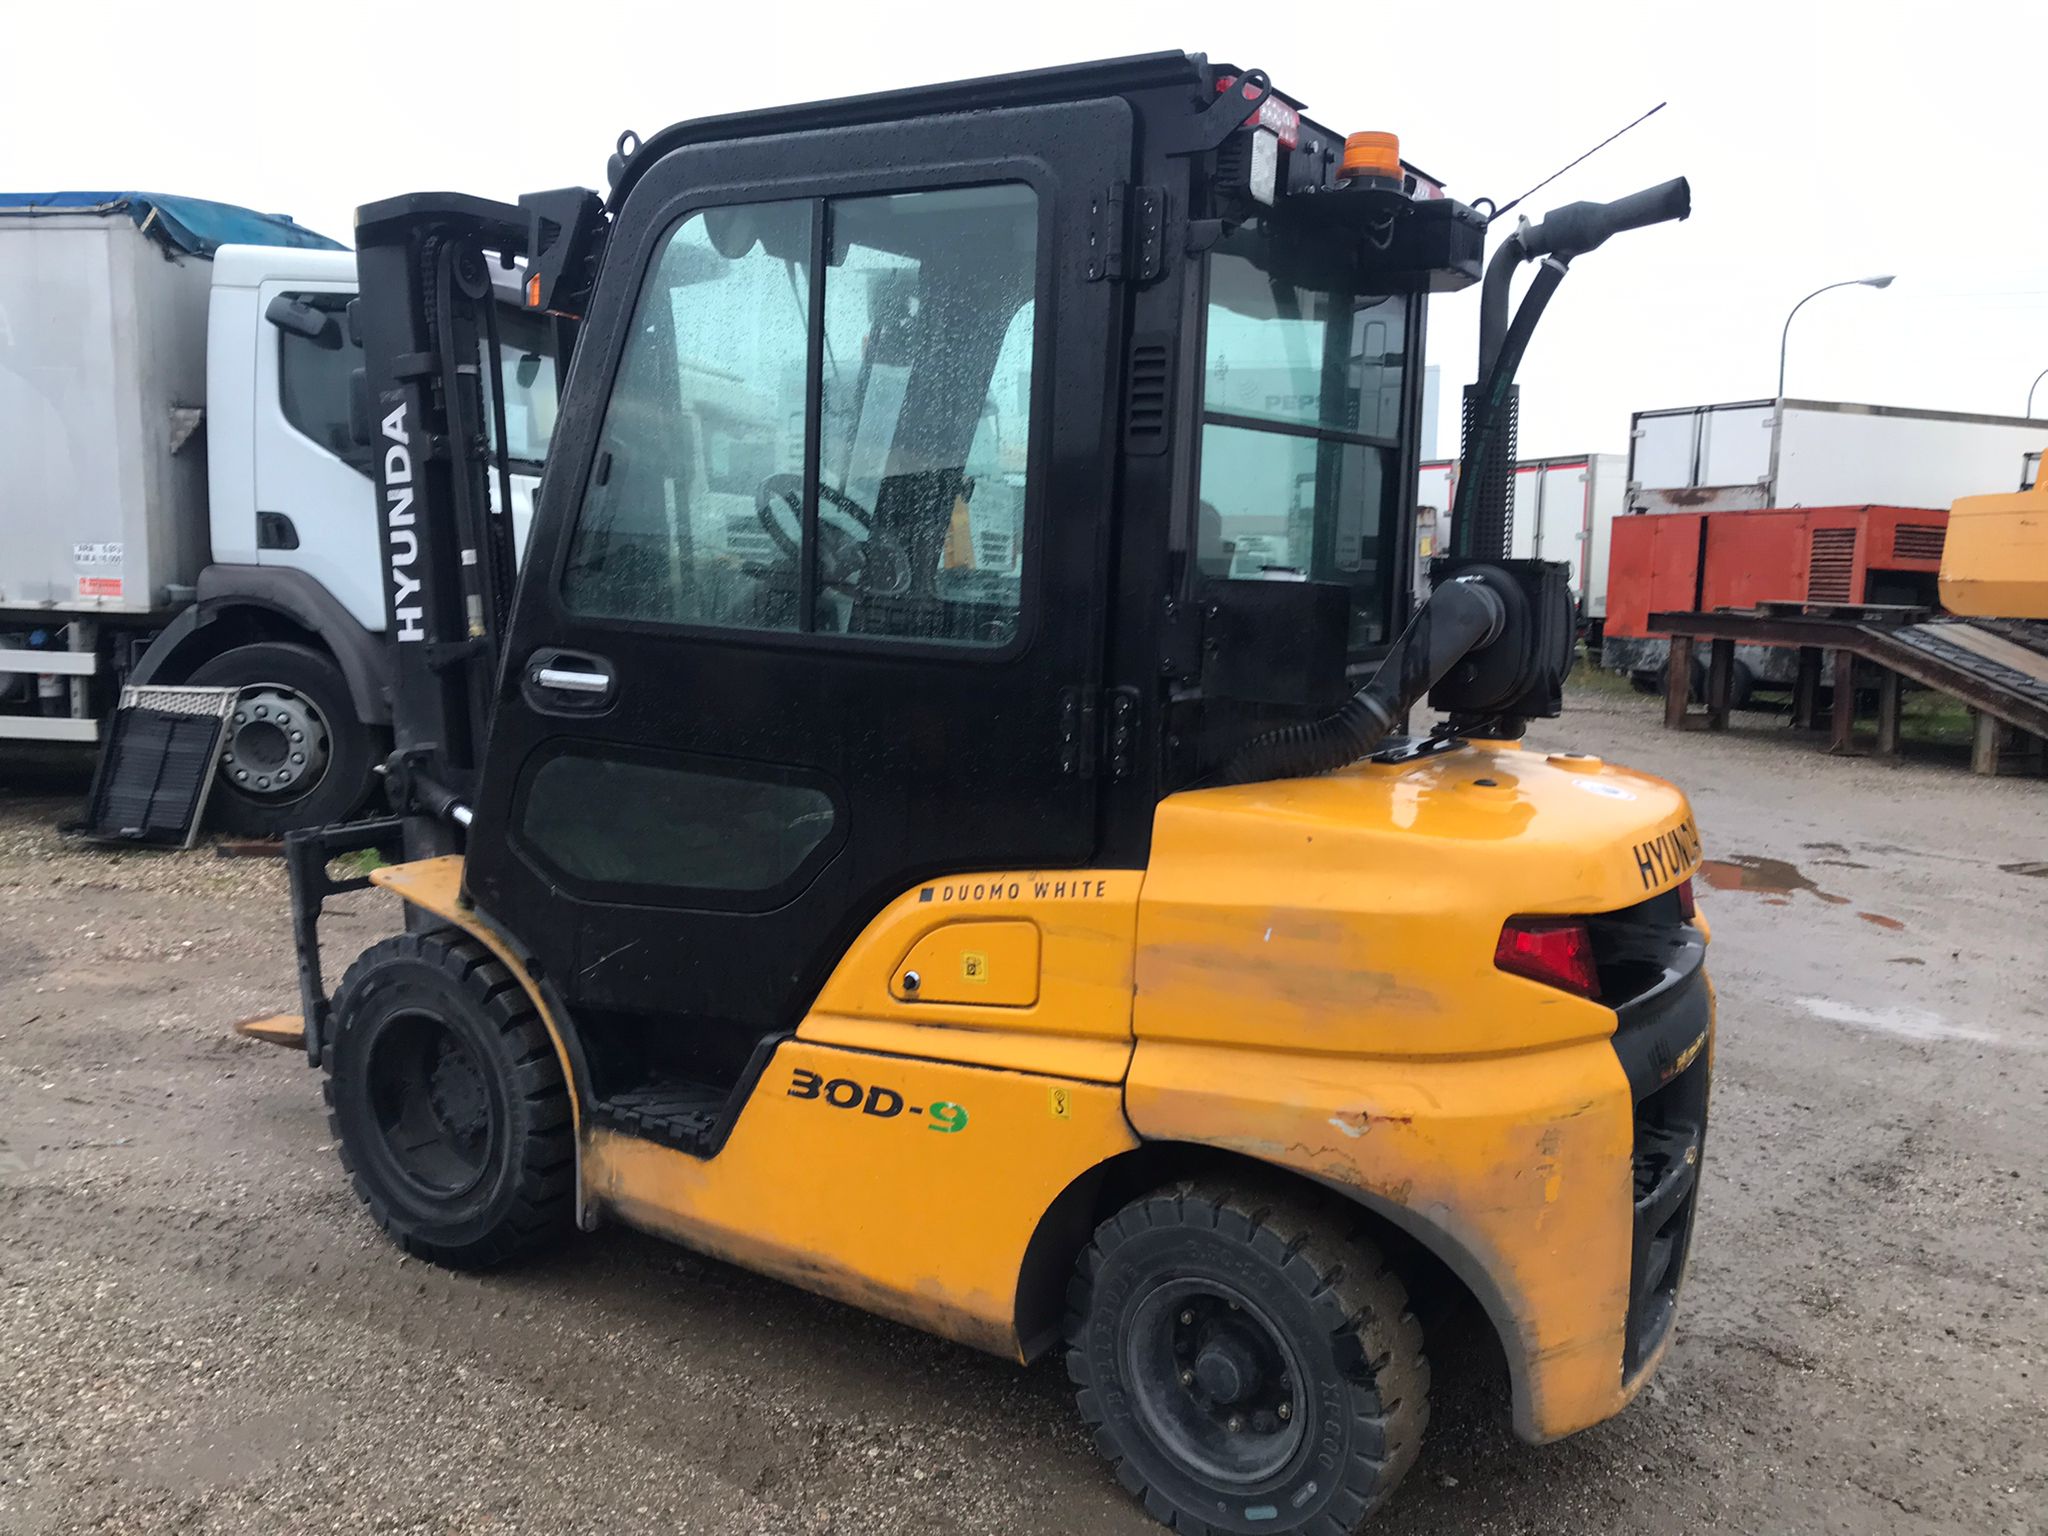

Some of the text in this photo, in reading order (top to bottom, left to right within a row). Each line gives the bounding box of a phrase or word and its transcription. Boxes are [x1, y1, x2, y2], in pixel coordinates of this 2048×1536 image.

[942, 880, 1107, 901] DUOMO WHITE
[786, 1067, 970, 1133] 30D-9
